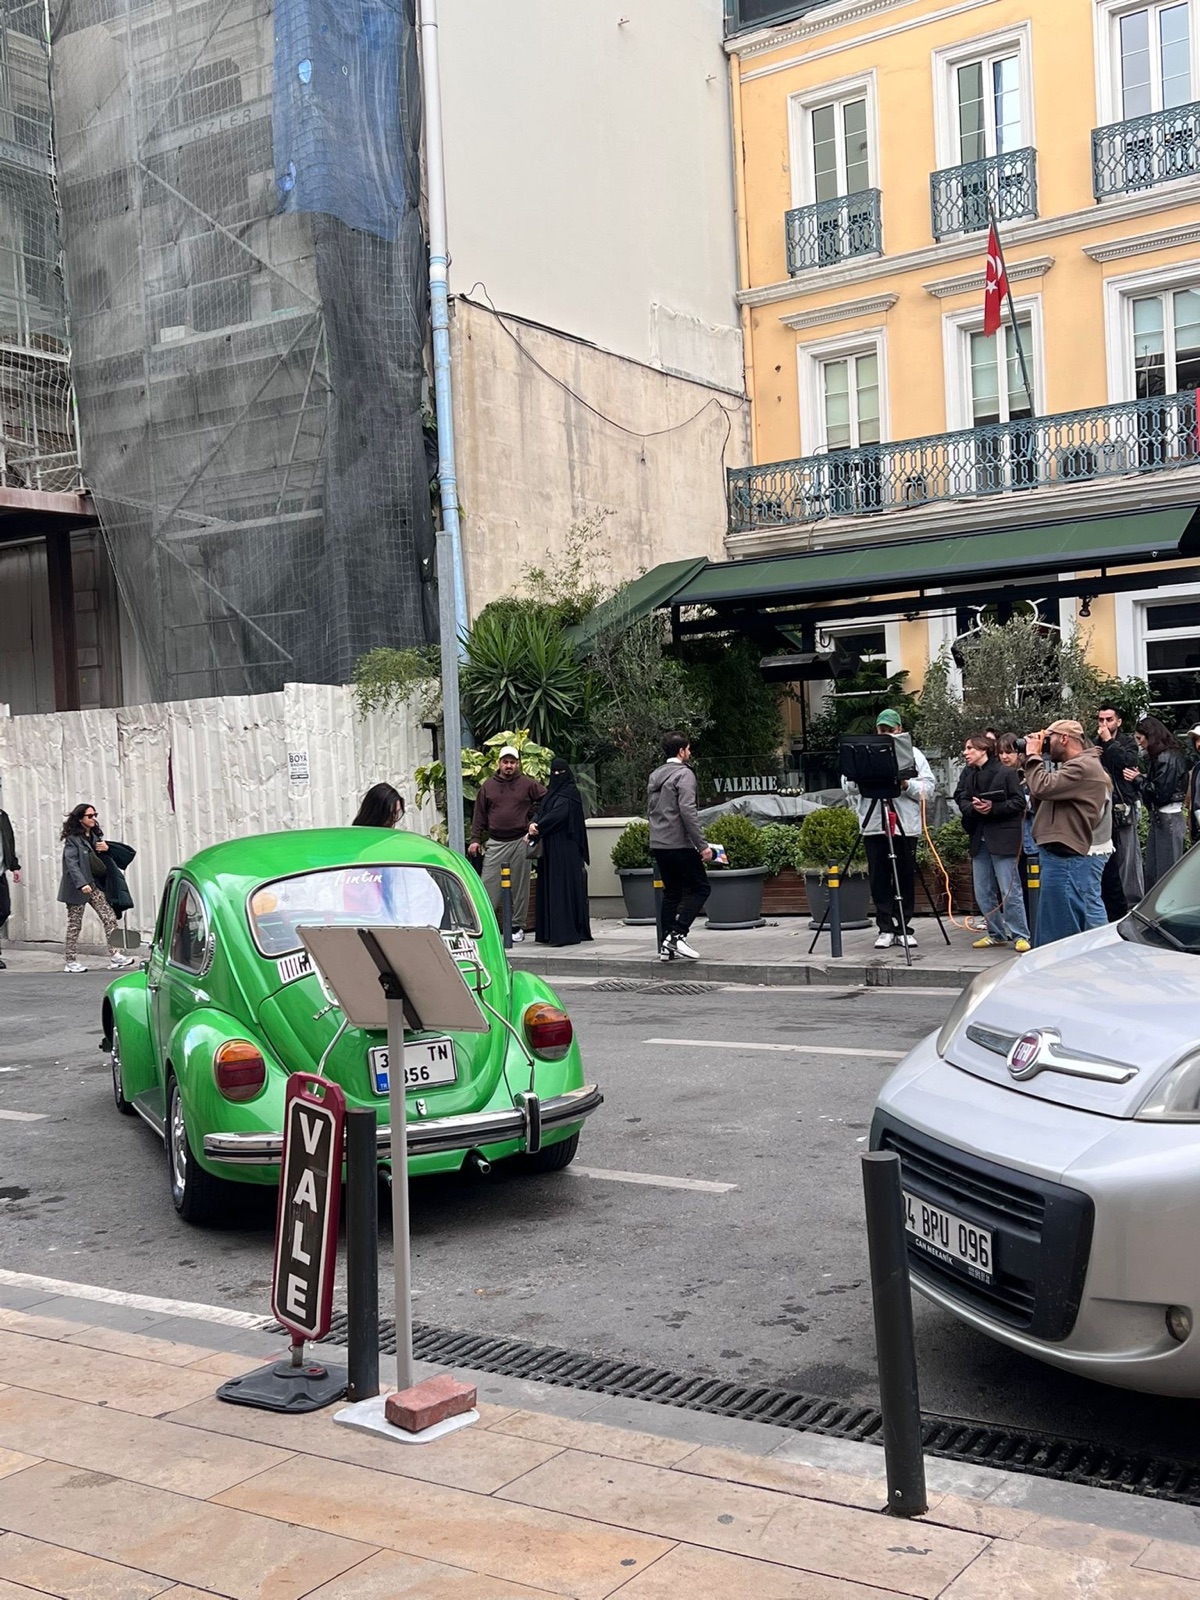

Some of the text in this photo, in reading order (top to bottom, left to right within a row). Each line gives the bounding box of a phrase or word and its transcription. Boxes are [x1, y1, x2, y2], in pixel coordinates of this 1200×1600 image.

[289, 755, 307, 763] BOYA
[713, 776, 778, 792] VALERIE
[427, 1044, 448, 1061] TN
[1013, 1041, 1037, 1062] FIAT
[286, 1111, 324, 1320] VALE
[915, 1238, 927, 1251] CAN
[922, 1204, 949, 1249] BPU
[959, 1223, 989, 1268] 096
